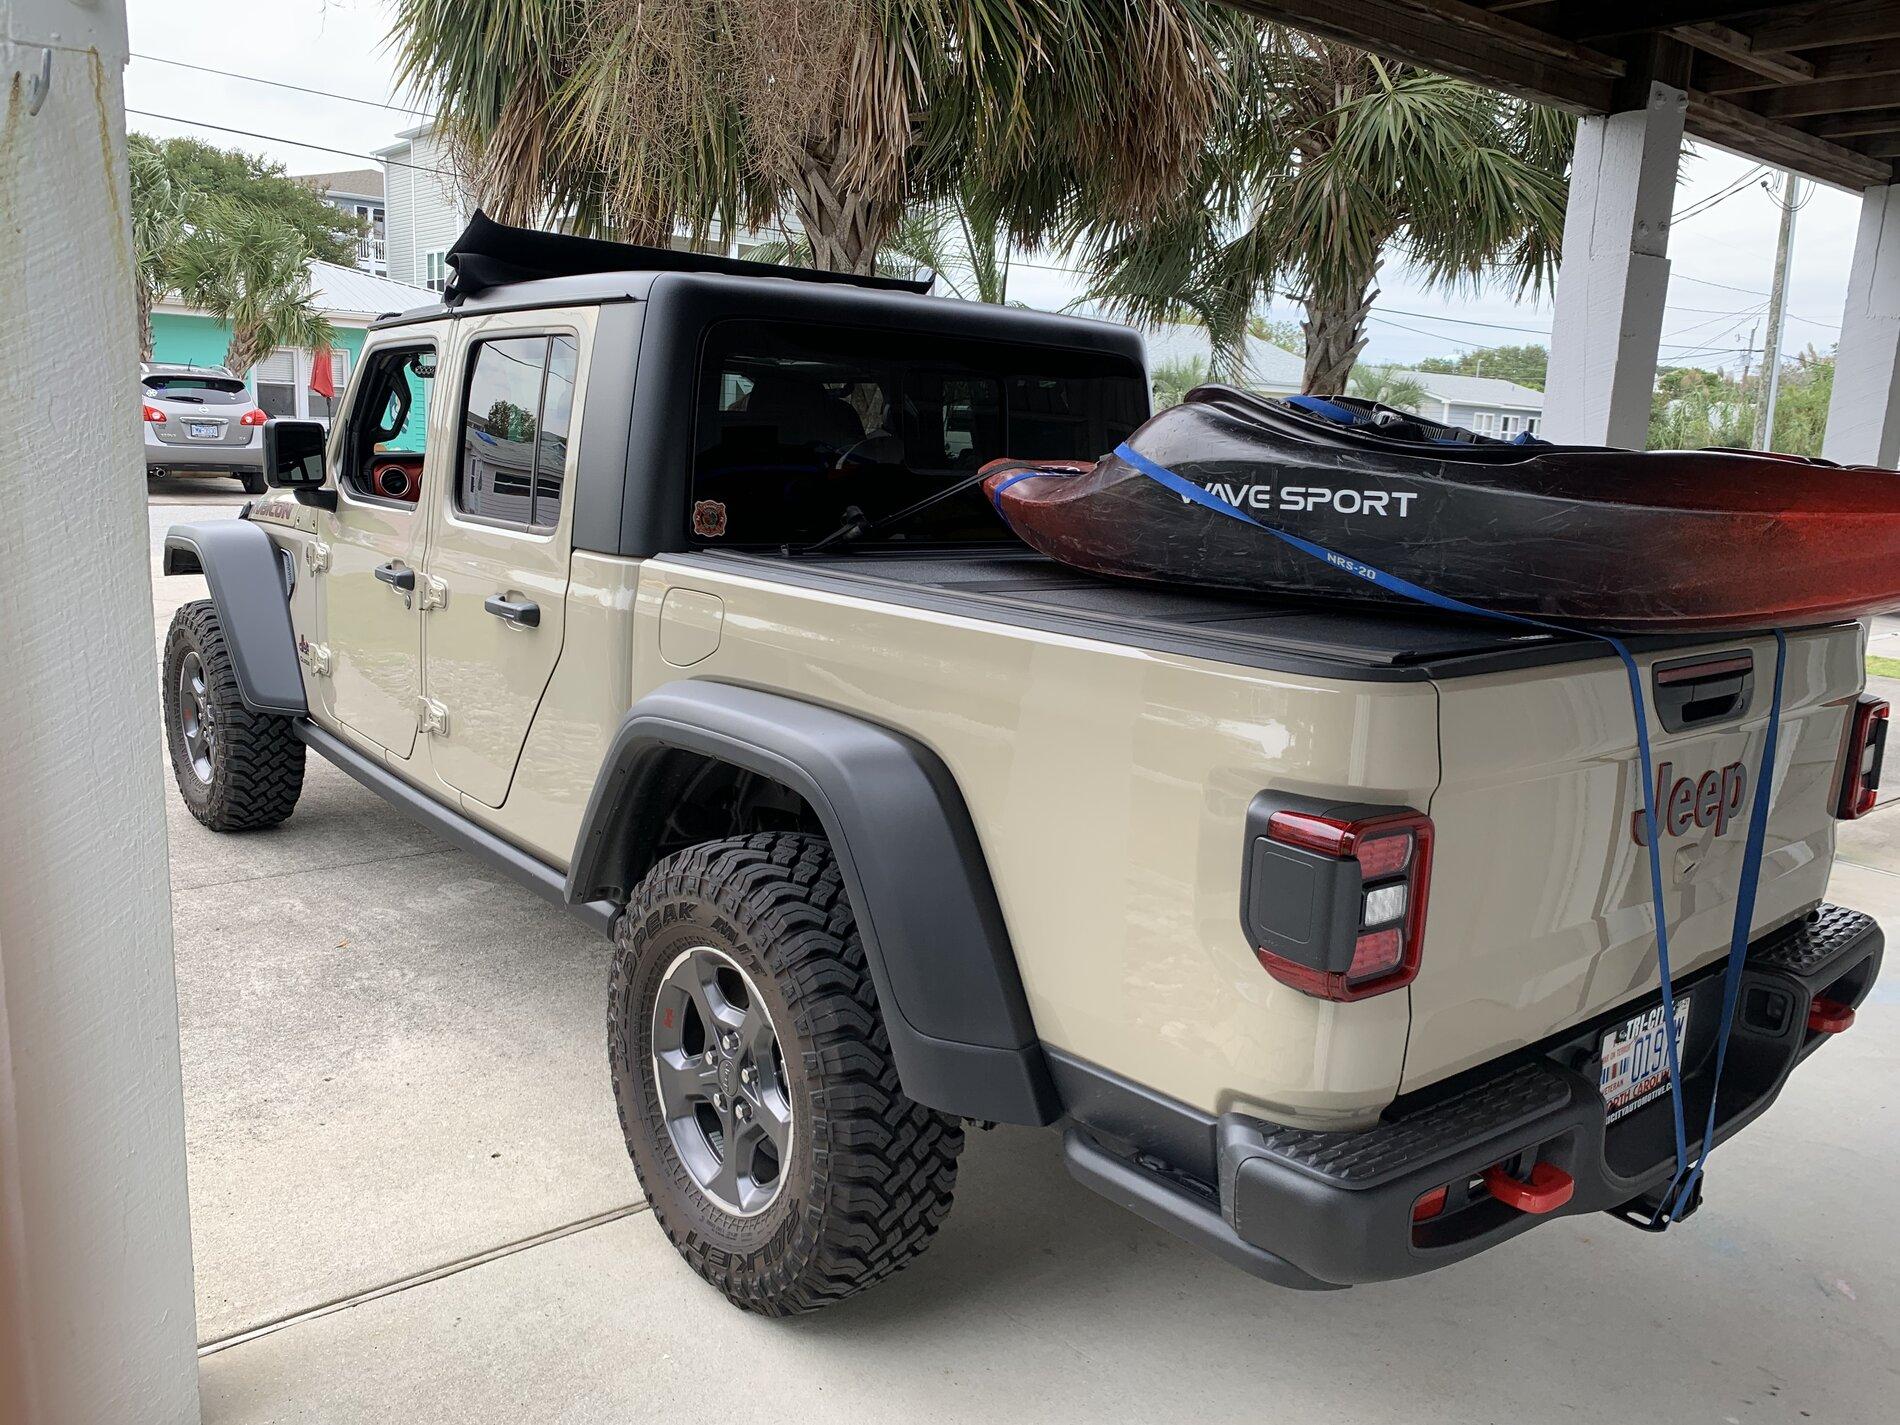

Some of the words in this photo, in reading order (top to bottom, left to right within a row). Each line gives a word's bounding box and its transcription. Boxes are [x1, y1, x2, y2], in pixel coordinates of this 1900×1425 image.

[1280, 486, 1417, 517] SPORT
[1327, 552, 1376, 580] NRS-20
[1631, 761, 1747, 846] Jeep
